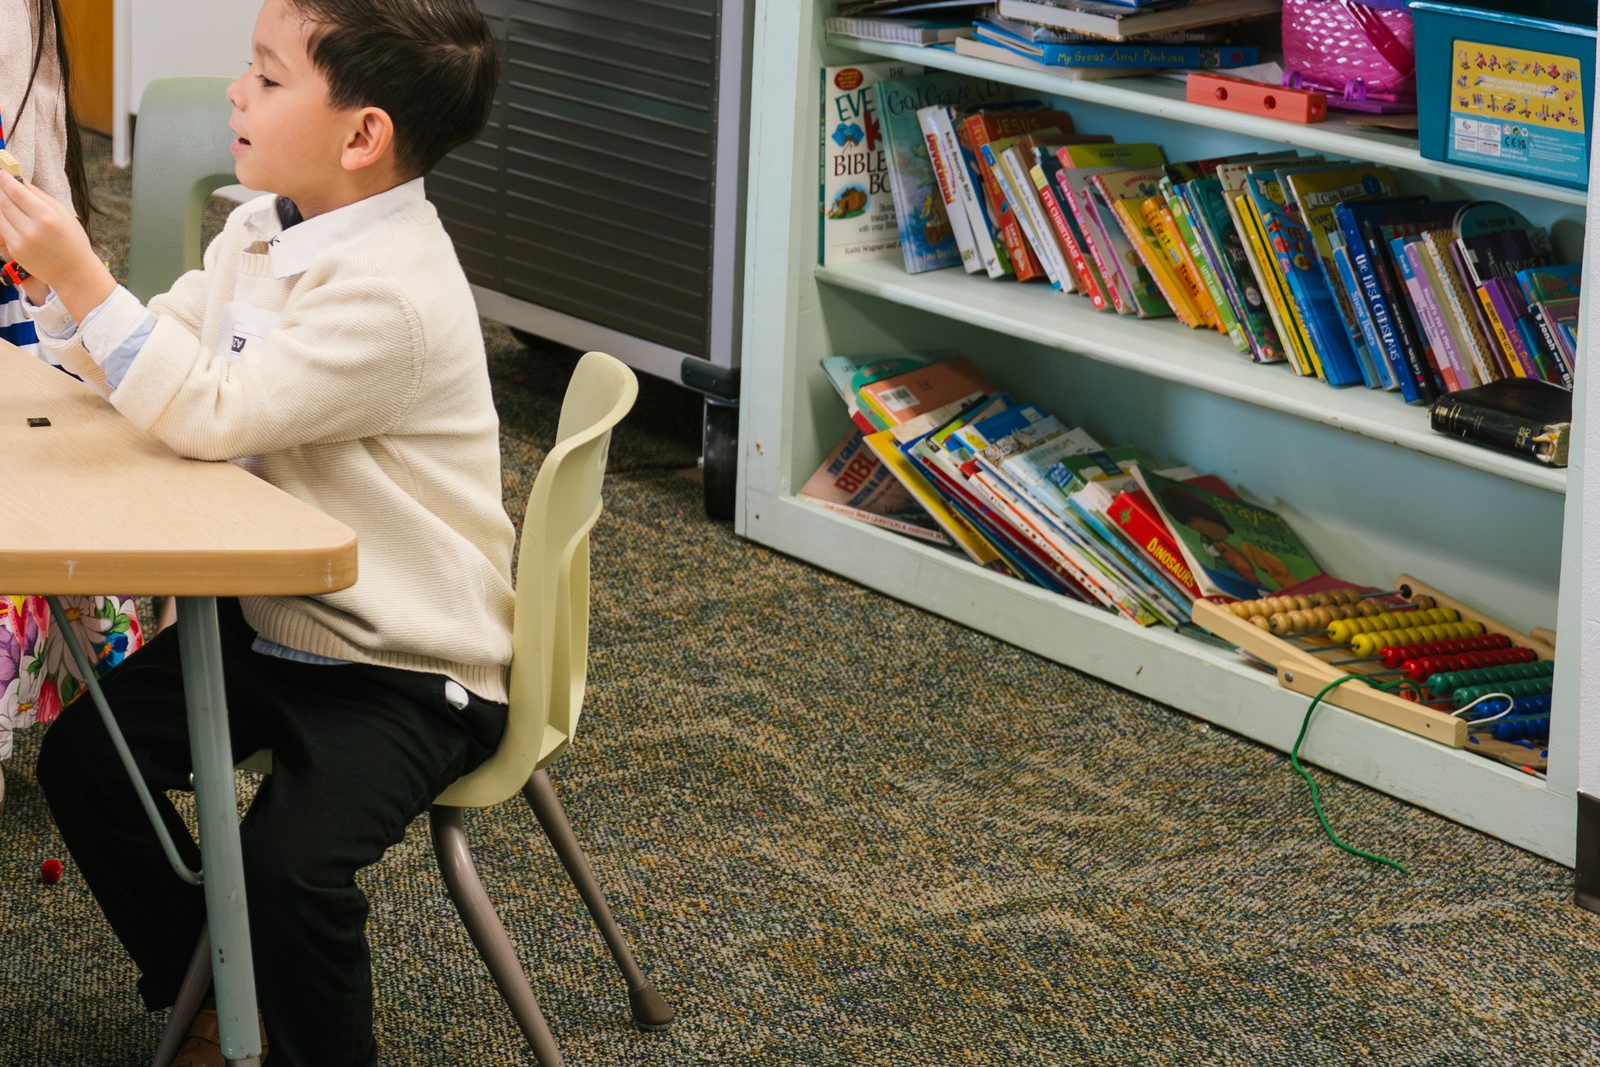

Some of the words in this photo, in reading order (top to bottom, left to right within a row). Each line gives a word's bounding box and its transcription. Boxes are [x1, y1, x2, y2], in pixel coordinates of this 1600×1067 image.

[1057, 52, 1072, 65] My
[1074, 49, 1105, 63] Great
[1110, 47, 1139, 62] Aunt
[888, 67, 906, 79] THE
[995, 118, 1040, 134] JESUS
[834, 150, 888, 177] BIBLE
[942, 130, 955, 151] Baby
[949, 149, 968, 184] Blessings
[961, 182, 974, 202] Bible
[1040, 190, 1055, 208] IT'S
[1319, 190, 1340, 204] Can
[1005, 222, 1021, 248] SARAH
[1047, 205, 1079, 259] CHRISTMAS!
[1189, 242, 1202, 257] 10
[1176, 262, 1201, 297] trucks
[1349, 290, 1366, 319] Snow
[1360, 318, 1377, 347] Bears
[1507, 327, 1524, 350] Let's
[1518, 348, 1536, 376] Share
[1537, 320, 1557, 351] Jonah
[1552, 350, 1562, 363] and
[1557, 361, 1566, 373] the
[826, 456, 846, 477] THE
[833, 446, 880, 498] BIBL
[1143, 536, 1198, 589] DINOSAURS
